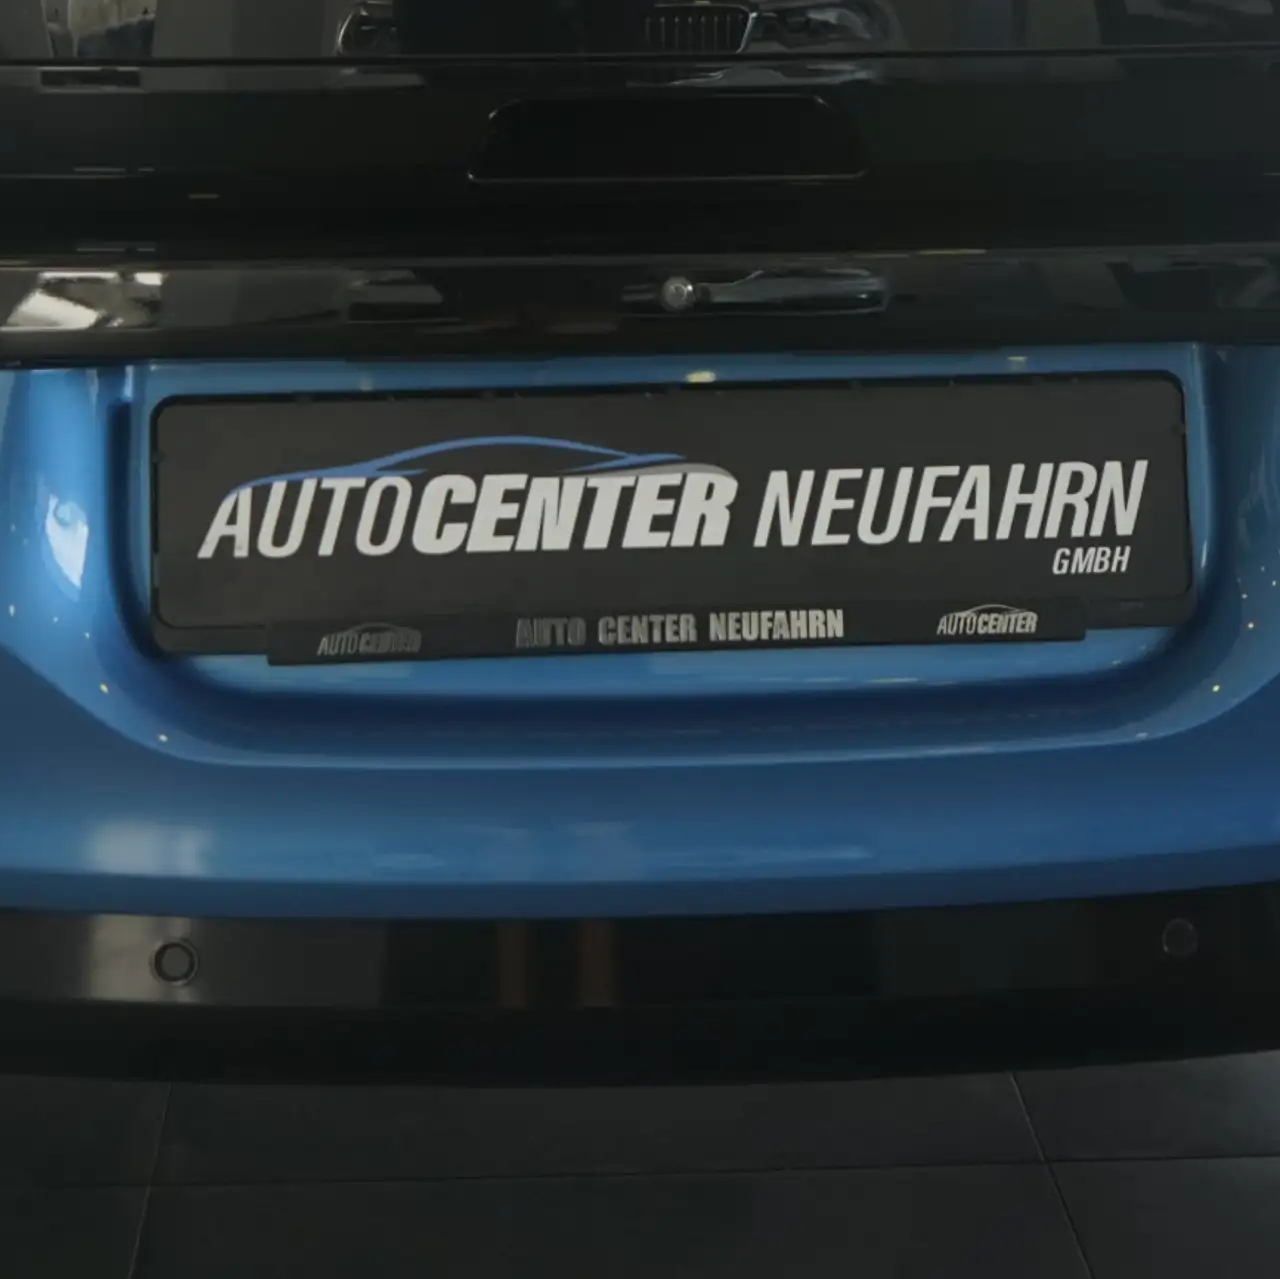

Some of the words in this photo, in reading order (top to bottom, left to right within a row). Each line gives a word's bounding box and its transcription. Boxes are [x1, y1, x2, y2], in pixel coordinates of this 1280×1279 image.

[197, 472, 738, 558] AUTOCENTER
[753, 460, 1148, 548] NEUFAHRN
[1052, 545, 1131, 575] GMBH
[515, 617, 586, 648] AUTO
[598, 614, 697, 645] CENTER
[709, 609, 844, 641] NEUFAHRN
[936, 610, 1038, 636] AUTOCENTER
